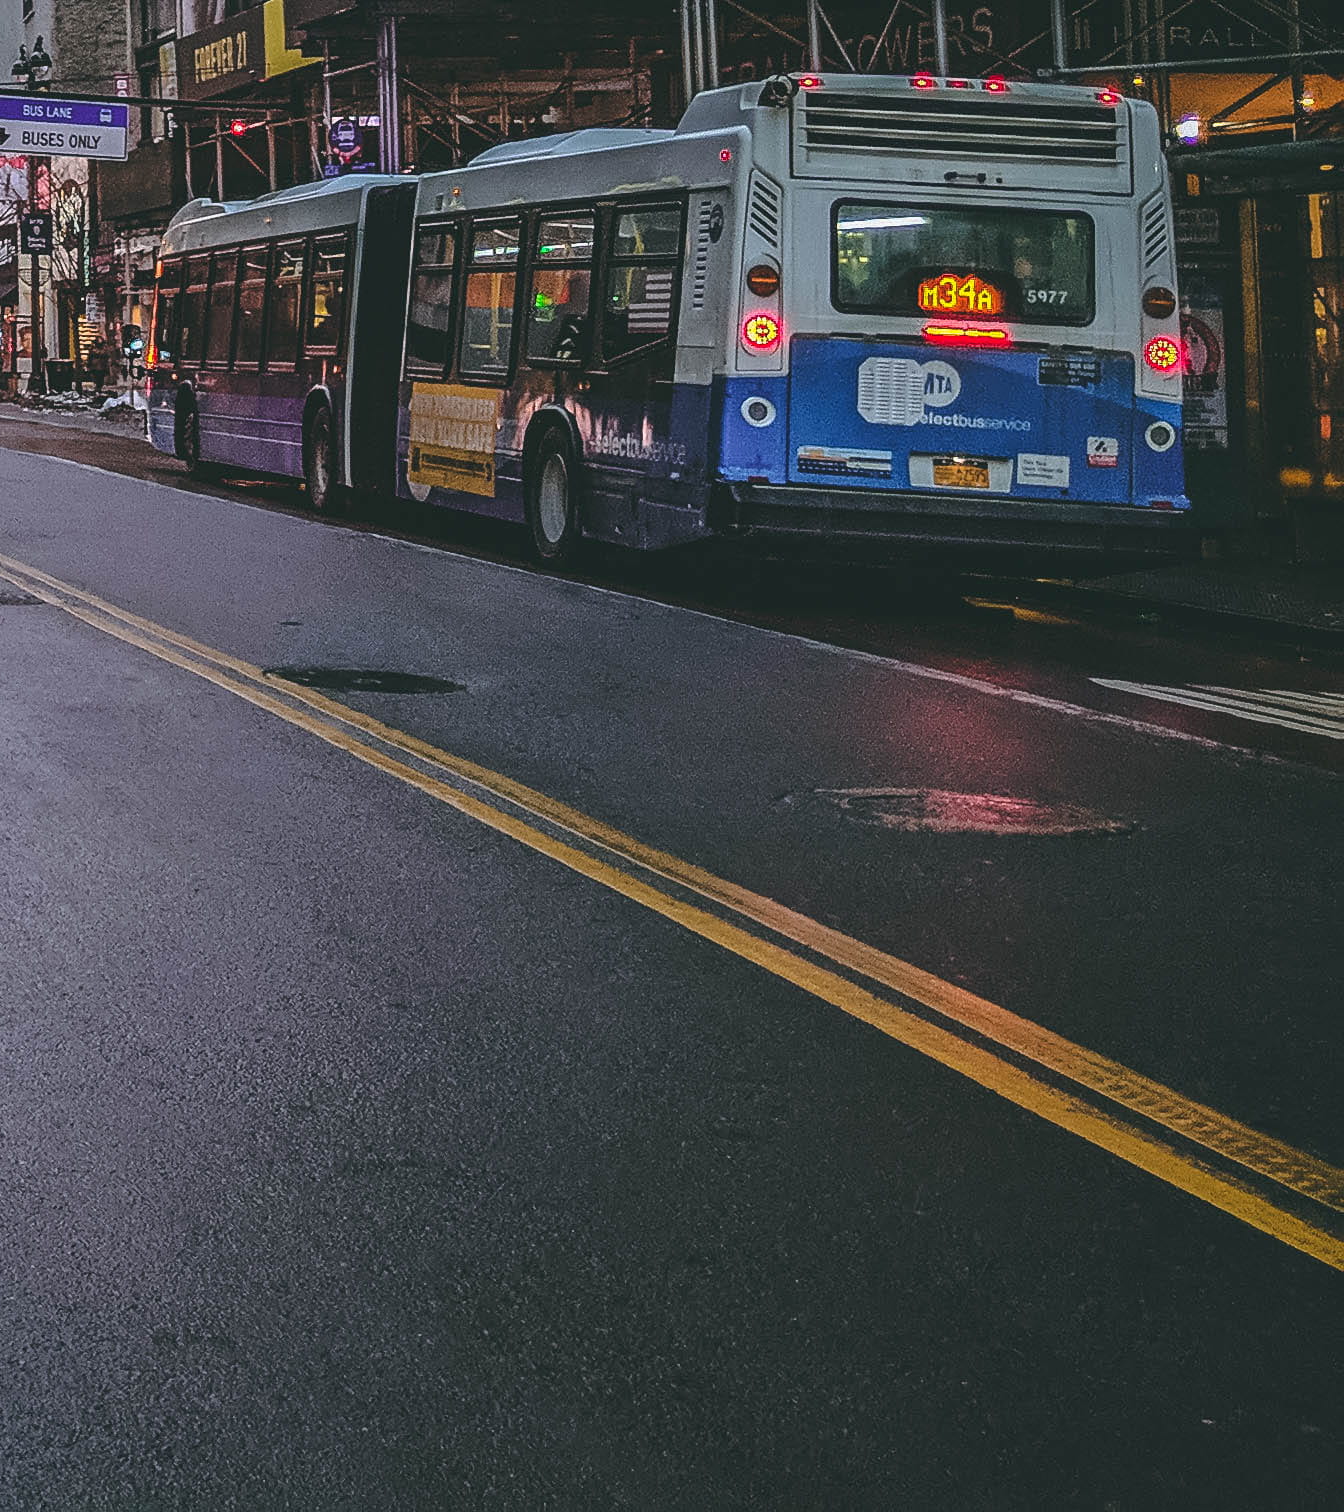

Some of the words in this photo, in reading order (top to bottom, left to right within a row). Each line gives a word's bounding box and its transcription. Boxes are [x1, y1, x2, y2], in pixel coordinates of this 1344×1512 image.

[845, 6, 993, 73] OWERS
[194, 36, 234, 84] FOREVER
[236, 31, 247, 70] 21
[22, 104, 43, 117] BUS
[46, 106, 73, 119] LANE
[22, 131, 64, 147] BUSES
[68, 134, 101, 150] ONLY
[922, 277, 993, 311] M34A
[1027, 290, 1068, 305] 5977
[918, 412, 1031, 431] electbusservice
